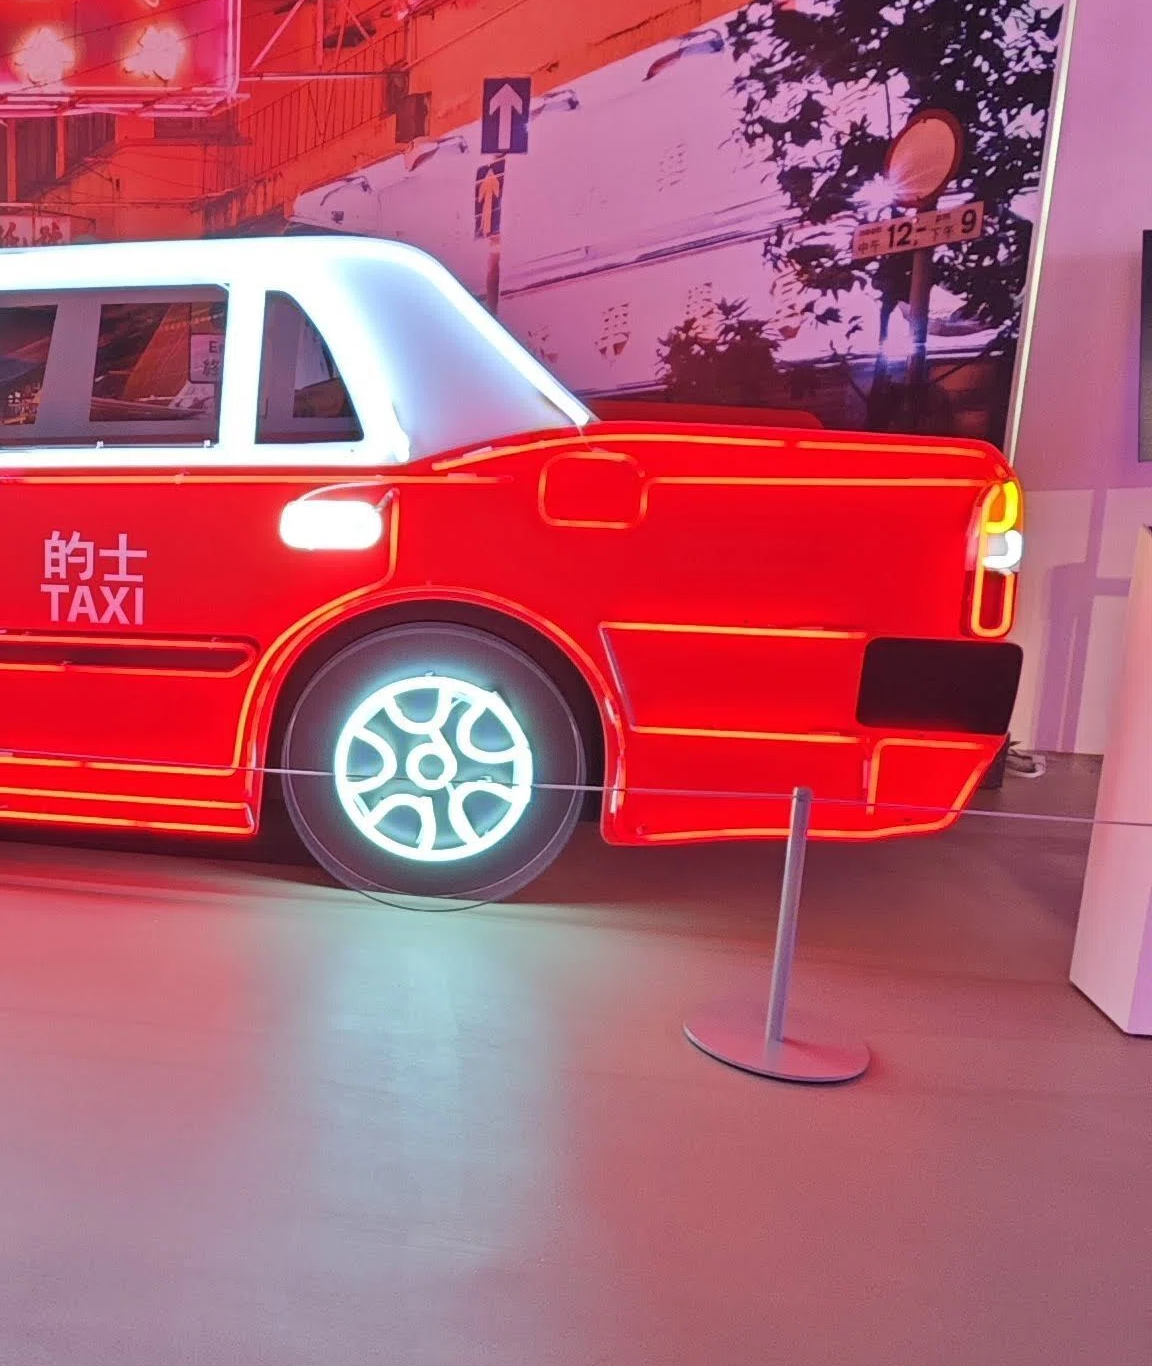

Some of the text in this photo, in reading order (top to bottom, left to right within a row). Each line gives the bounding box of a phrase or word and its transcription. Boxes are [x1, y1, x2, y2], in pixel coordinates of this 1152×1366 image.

[961, 209, 977, 234] 9
[44, 530, 148, 582] 的士
[40, 583, 144, 625] TAXI
